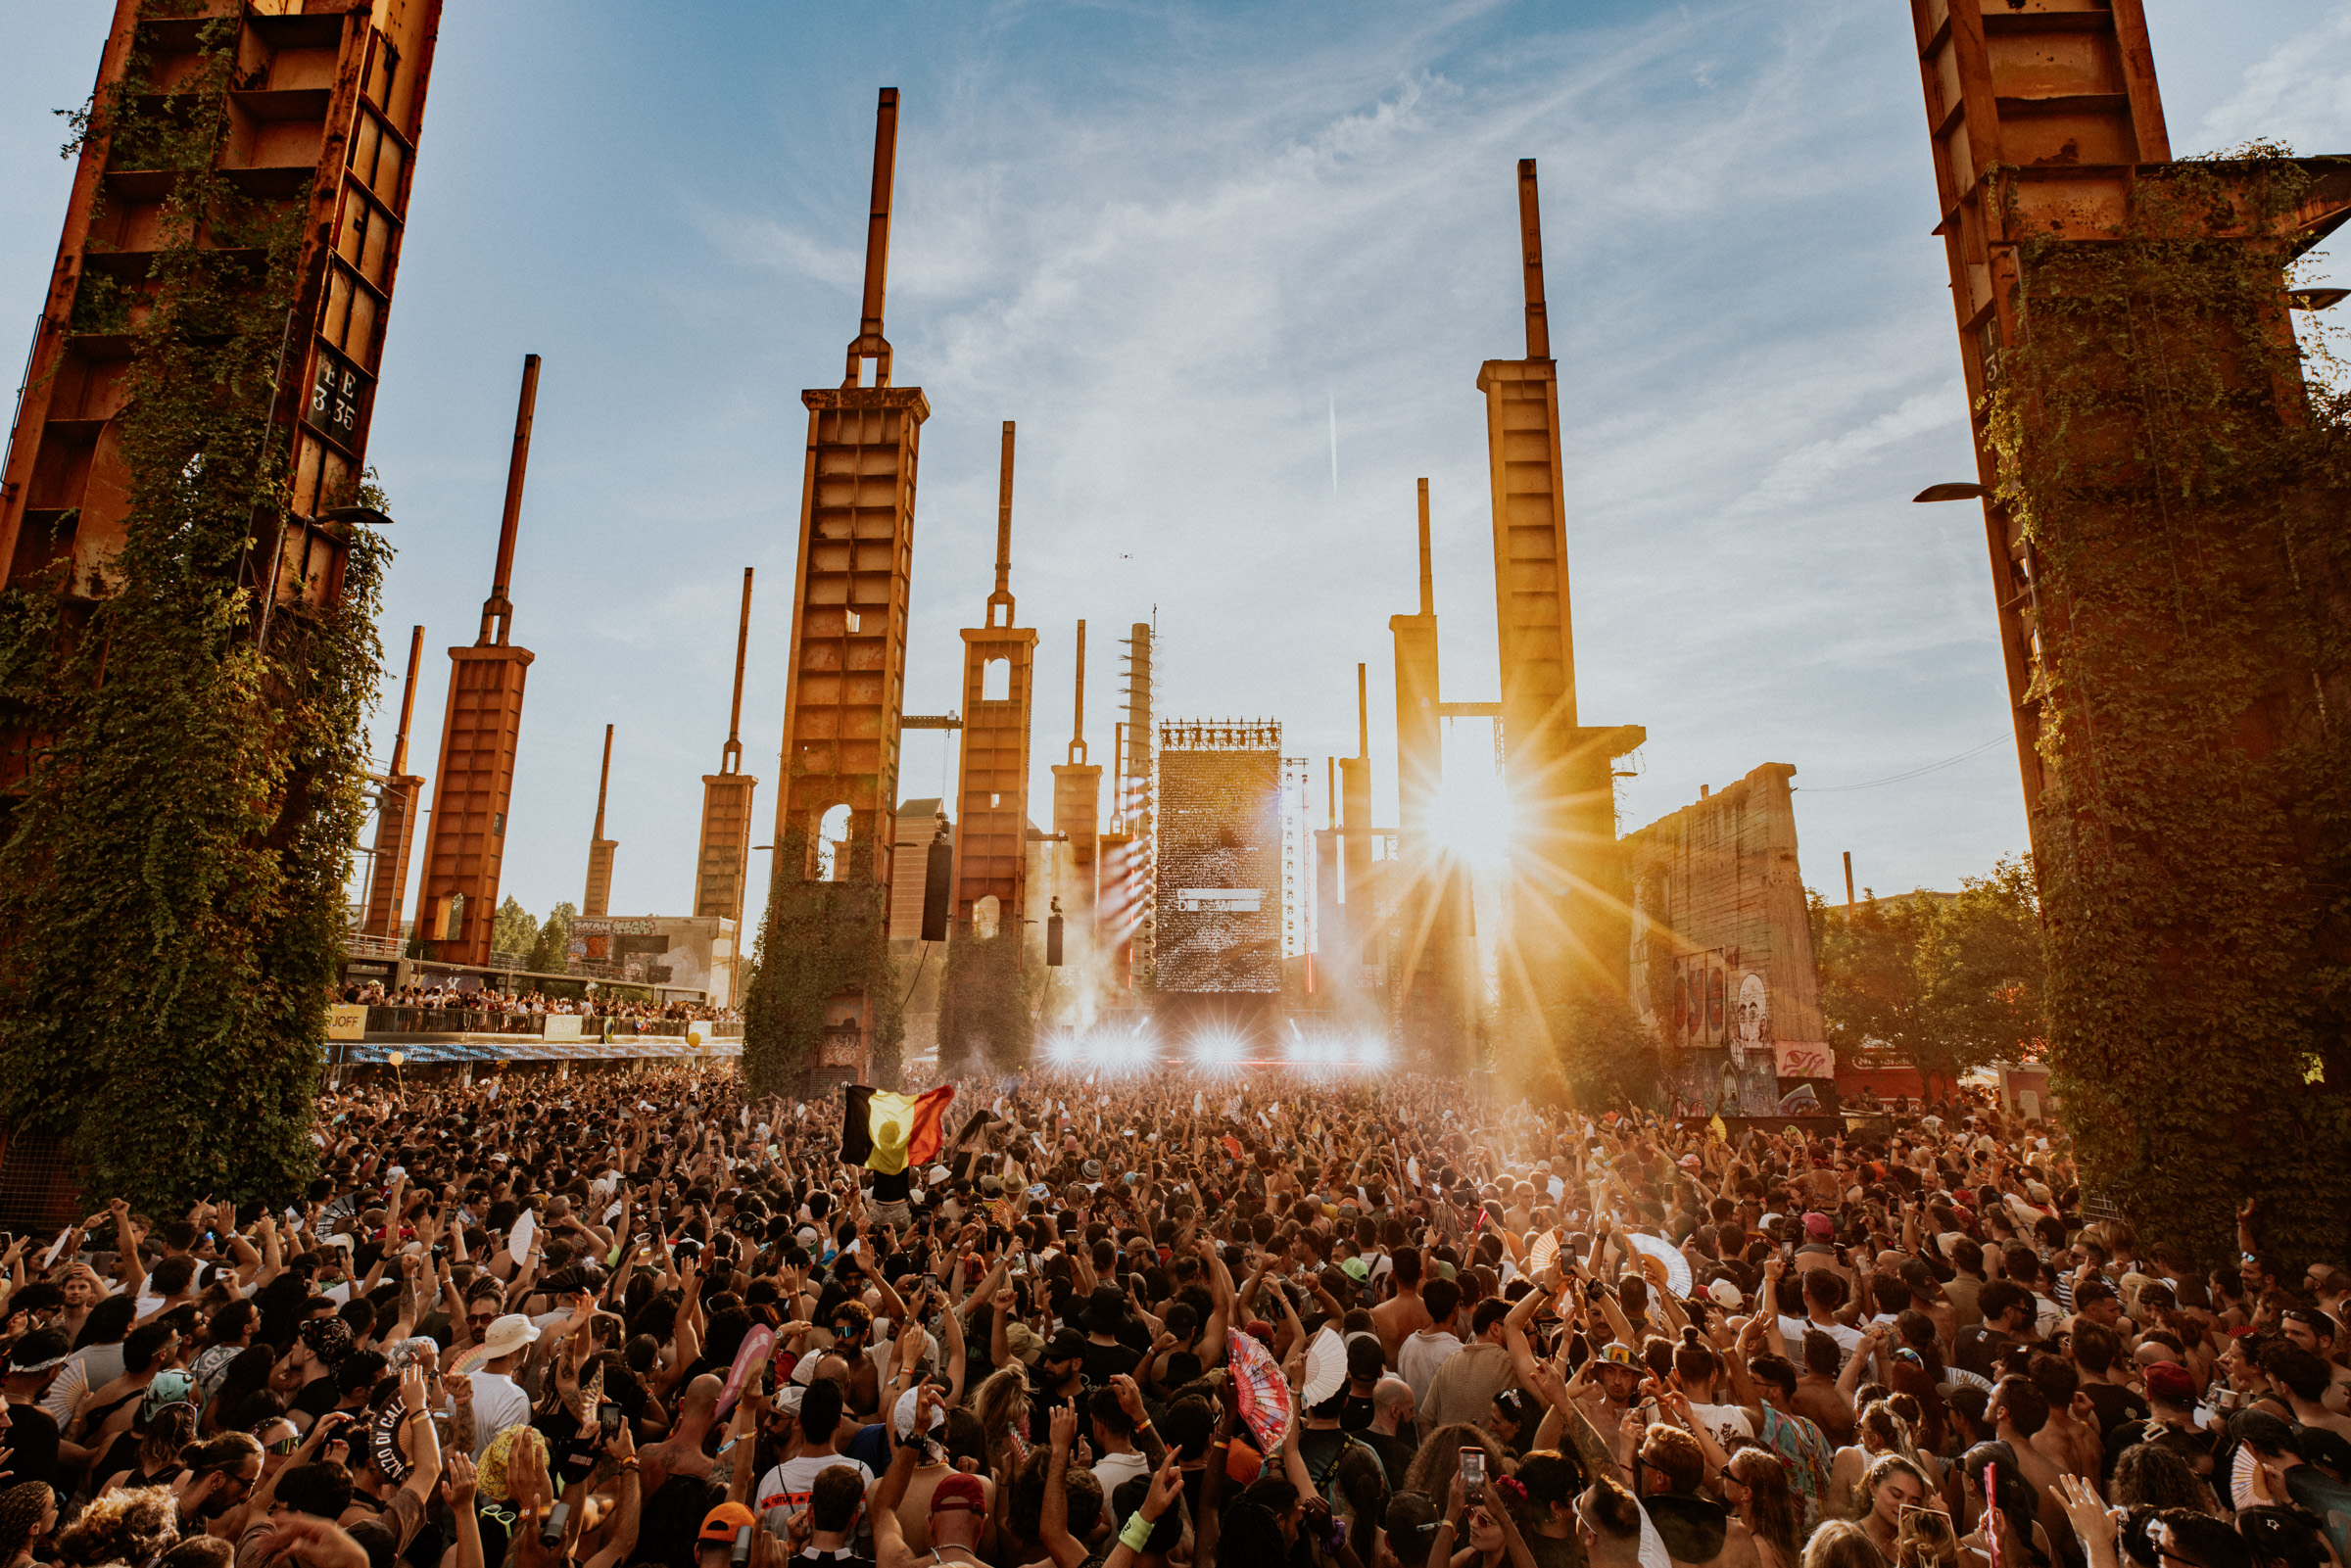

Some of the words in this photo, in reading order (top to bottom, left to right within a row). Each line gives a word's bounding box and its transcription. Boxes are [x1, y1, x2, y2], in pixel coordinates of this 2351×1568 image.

[324, 365, 336, 388] E
[341, 371, 357, 399] E
[312, 384, 327, 411] 3
[333, 398, 356, 431] 35
[375, 1431, 392, 1446] DI
[377, 1448, 405, 1480] AZZO
